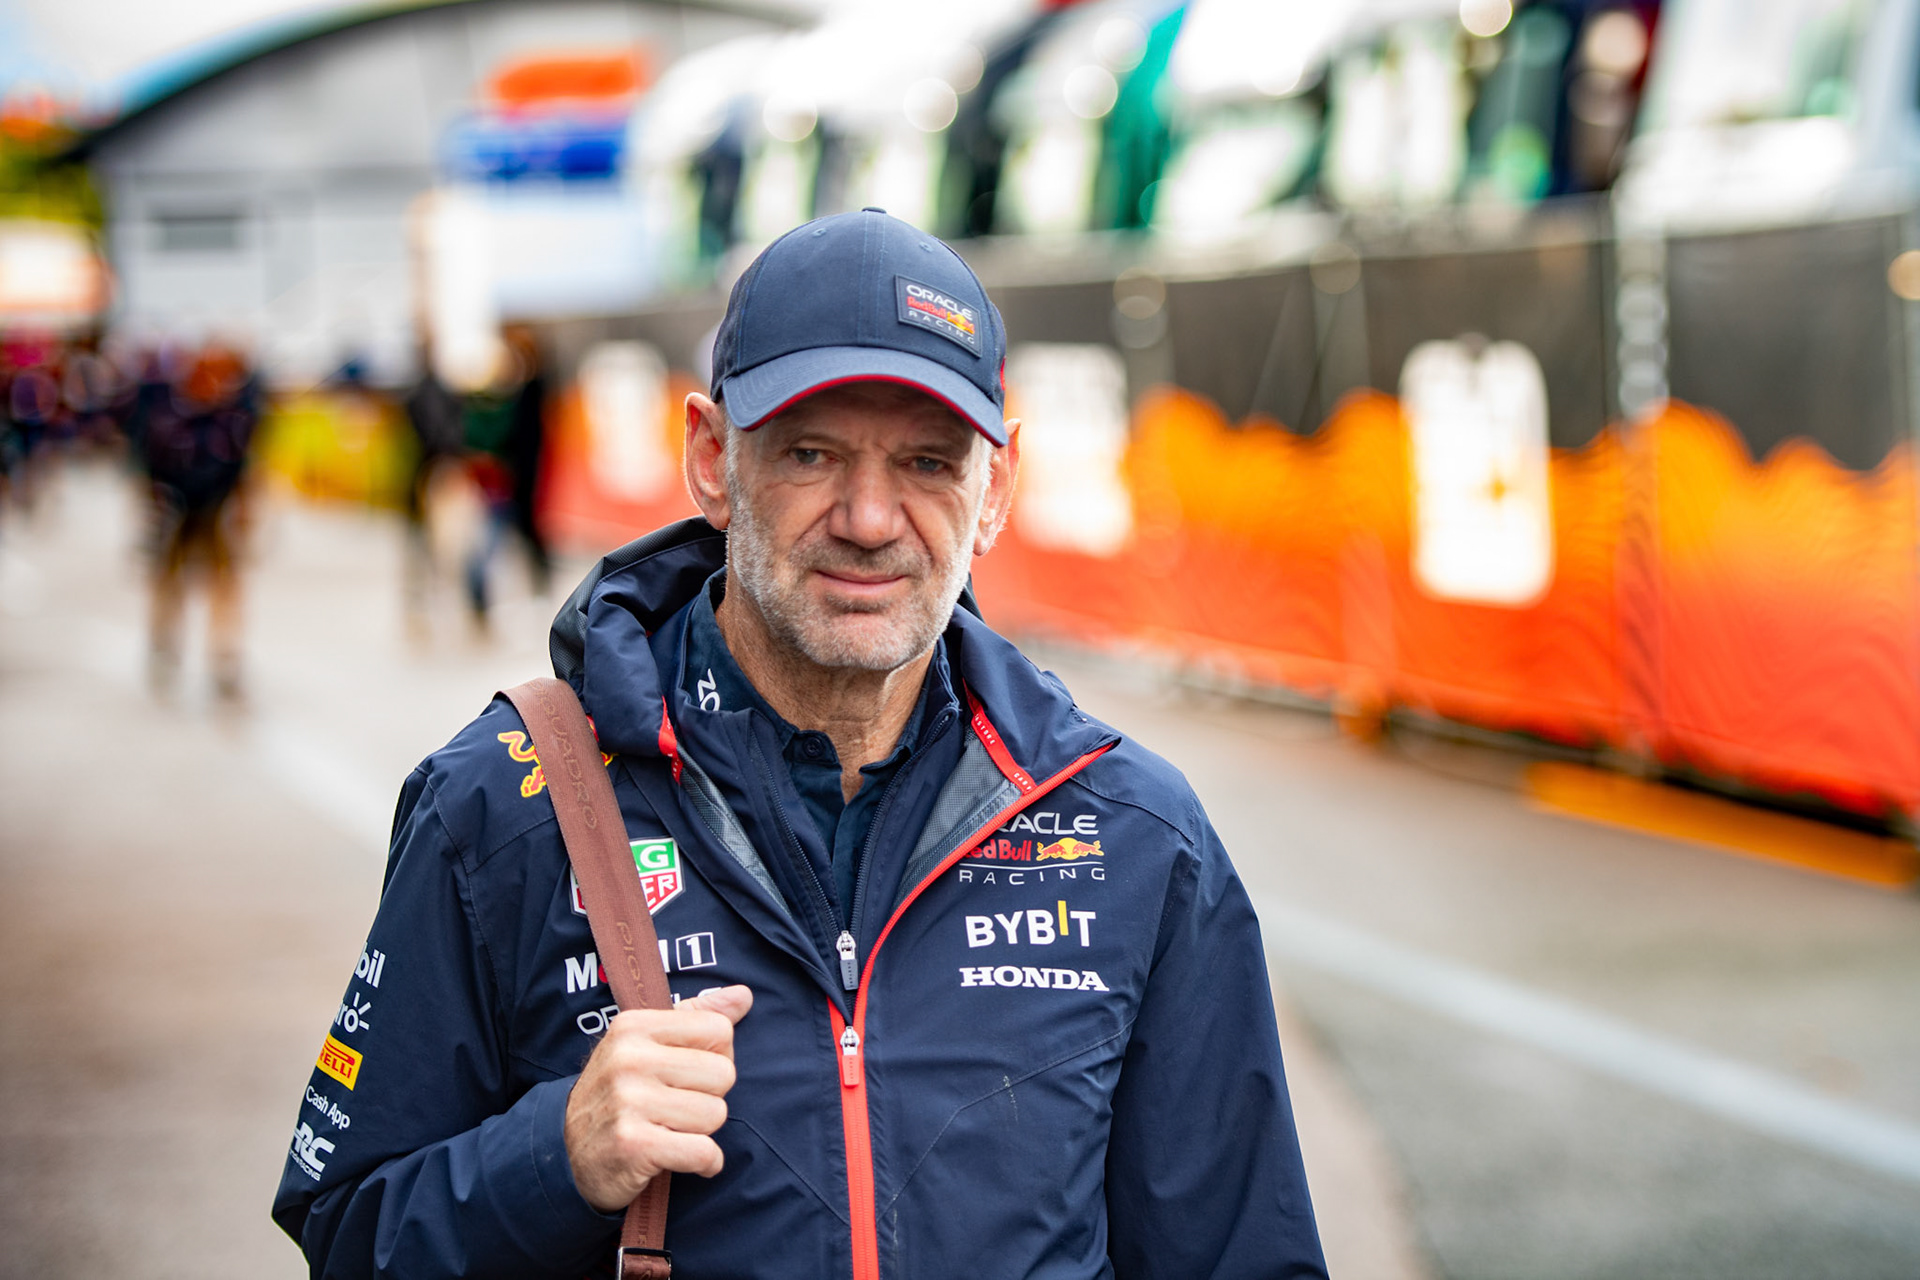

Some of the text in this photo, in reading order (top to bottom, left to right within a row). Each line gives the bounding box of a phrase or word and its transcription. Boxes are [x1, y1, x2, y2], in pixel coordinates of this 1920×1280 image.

[906, 284, 973, 321] ORACLE
[908, 310, 975, 344] RACING
[1000, 811, 1099, 835] ACLE
[967, 839, 1033, 862] ed Bull
[958, 867, 1106, 886] RACING
[965, 900, 1097, 948] BYBIT
[354, 942, 386, 988] bil
[616, 921, 648, 1009] PIQU
[958, 965, 1110, 992] HONDA
[306, 1085, 351, 1130] Cash App
